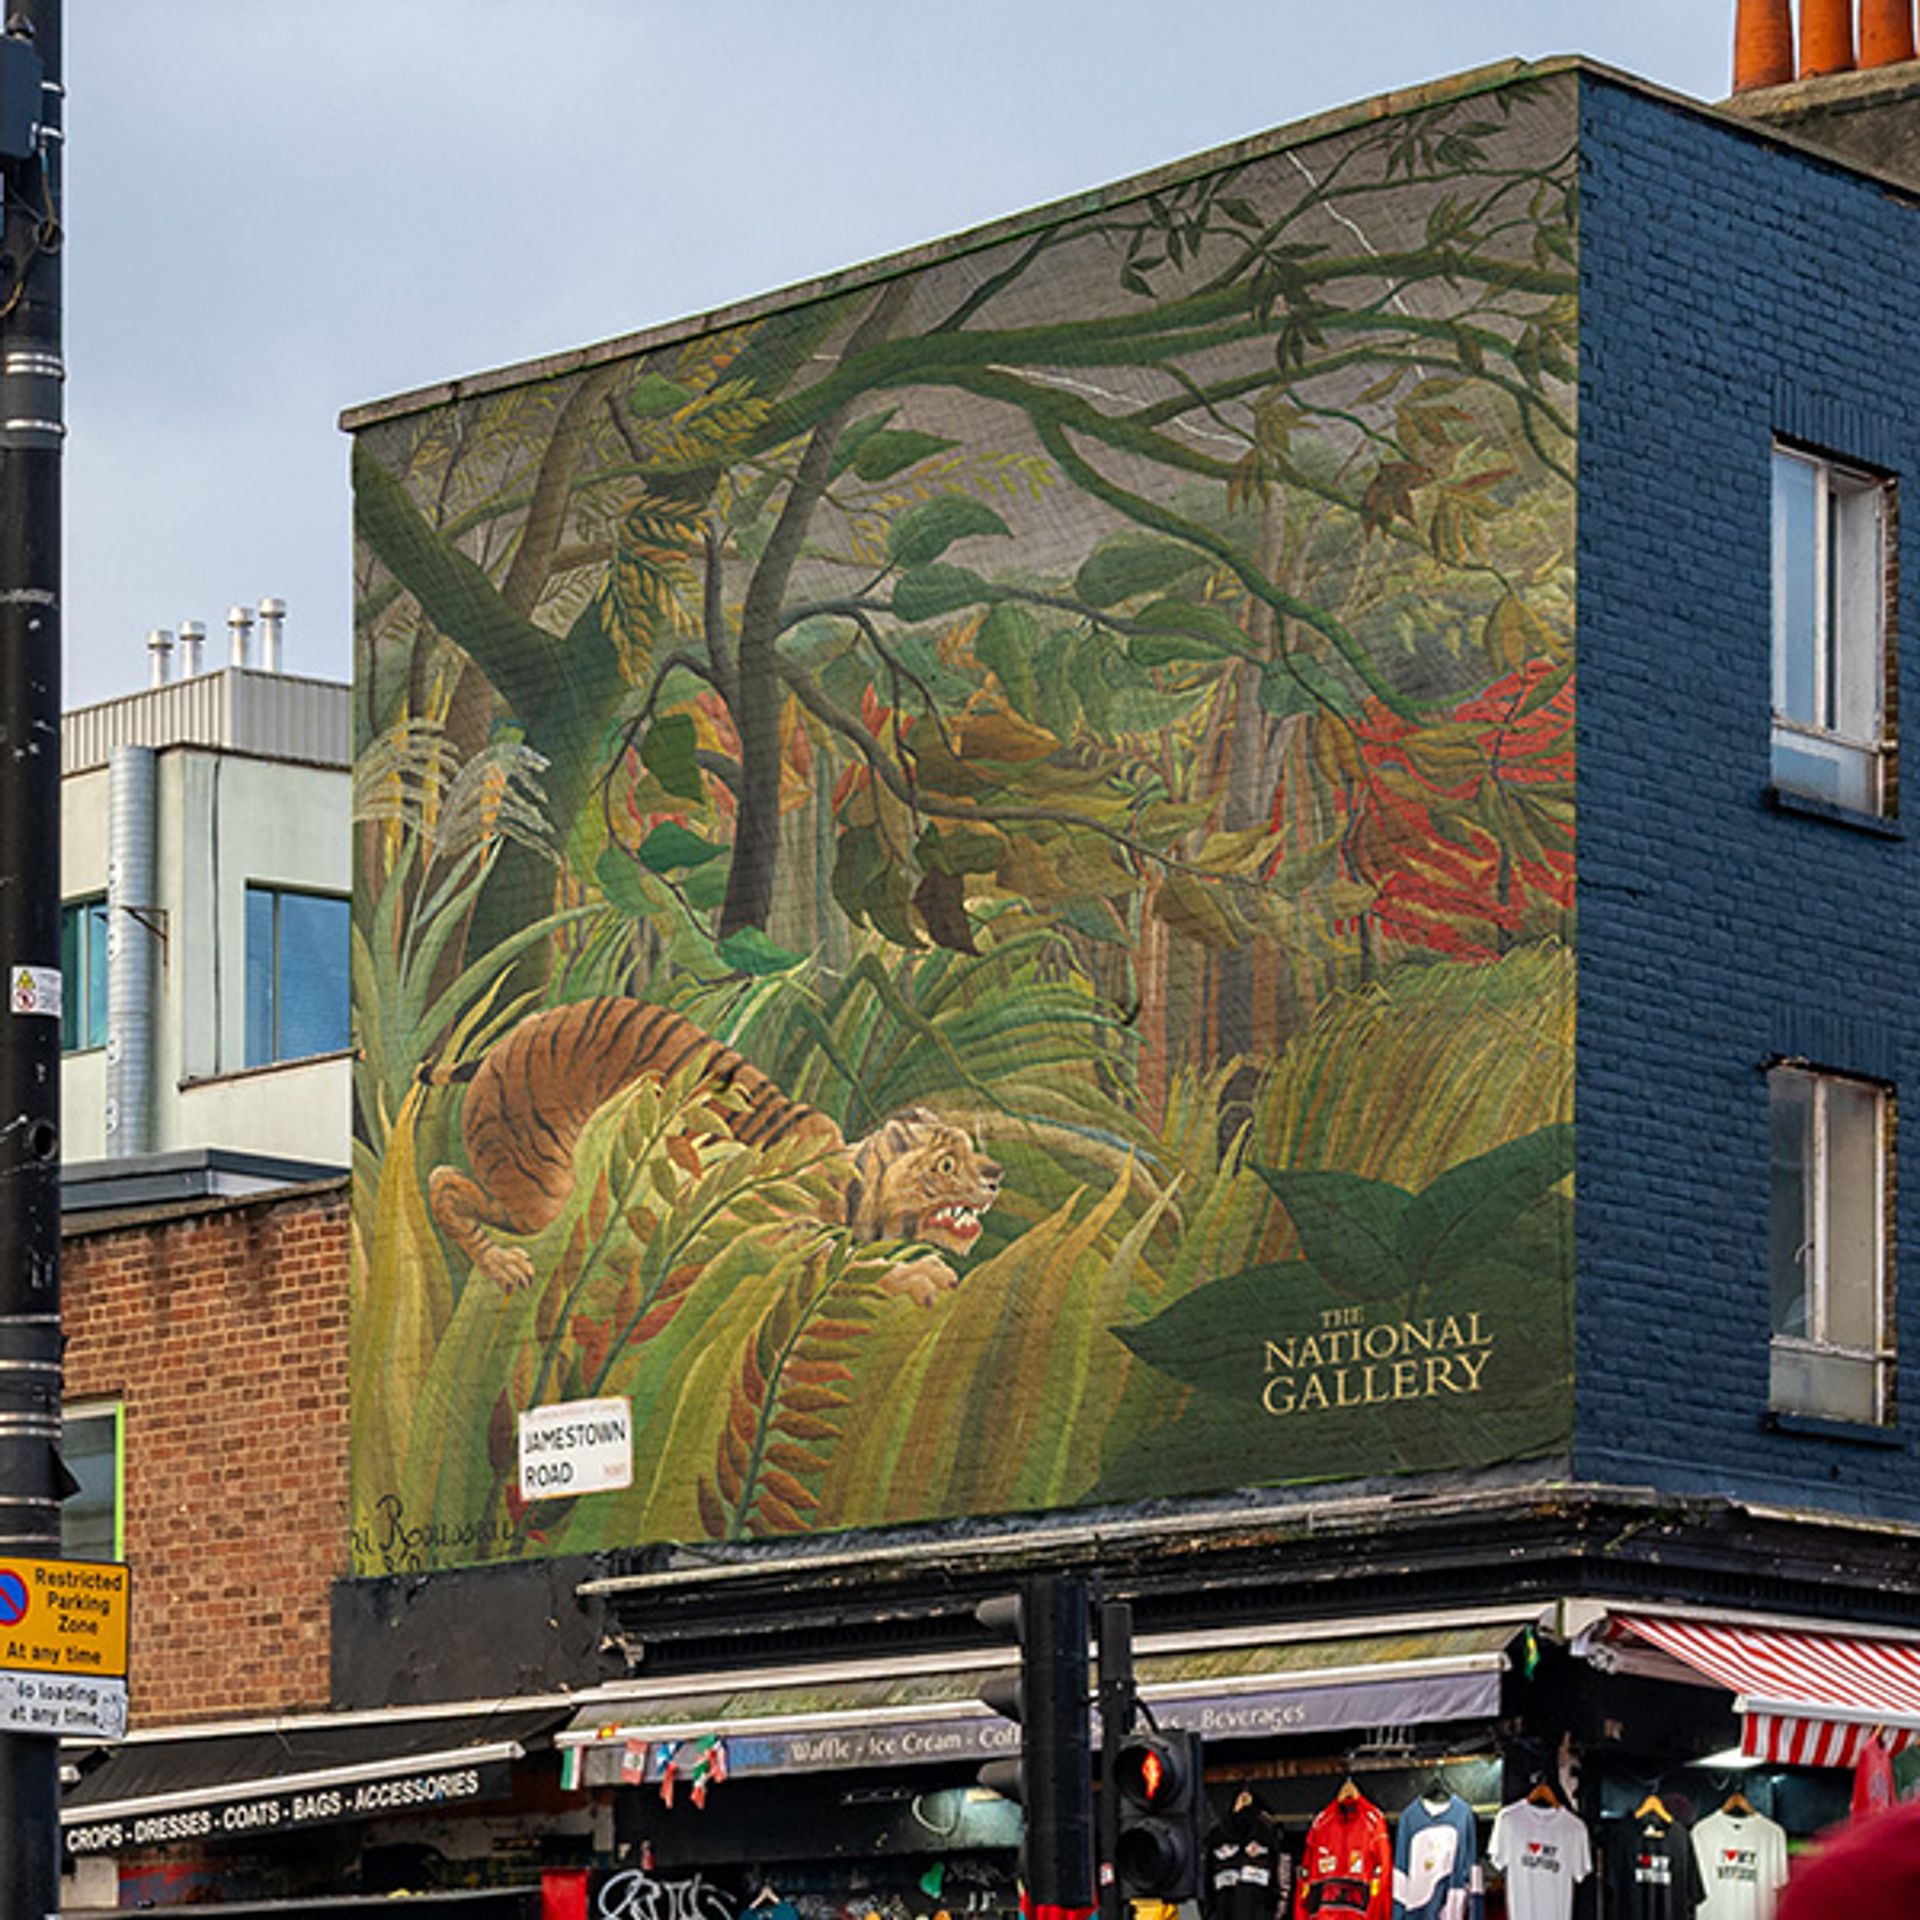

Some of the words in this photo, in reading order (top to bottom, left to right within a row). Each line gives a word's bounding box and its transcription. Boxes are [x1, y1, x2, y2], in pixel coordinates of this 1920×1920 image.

[1320, 1306, 1364, 1328] THE
[1263, 1311, 1494, 1373] NATIONAL
[1262, 1350, 1492, 1415] GALLERY
[525, 1420, 625, 1454] JAMESTOWN
[525, 1461, 573, 1488] ROAD
[35, 1567, 122, 1591] Restricted
[48, 1591, 110, 1616] Parking
[57, 1615, 98, 1635] Zone
[7, 1641, 26, 1659] At
[32, 1647, 60, 1664] any
[66, 1645, 101, 1664] time
[39, 1681, 97, 1706] loading
[9, 1705, 26, 1721] at
[31, 1708, 59, 1726] any
[64, 1706, 97, 1726] time
[869, 1736, 895, 1756] Ice
[901, 1732, 963, 1752] Cream
[1202, 1703, 1305, 1734] Beverages
[66, 1823, 123, 1852] CROPS
[133, 1810, 212, 1844] DRESSES
[223, 1800, 280, 1830] COATS
[292, 1791, 342, 1821] BAGS
[354, 1769, 479, 1812] ACCESSORIES
